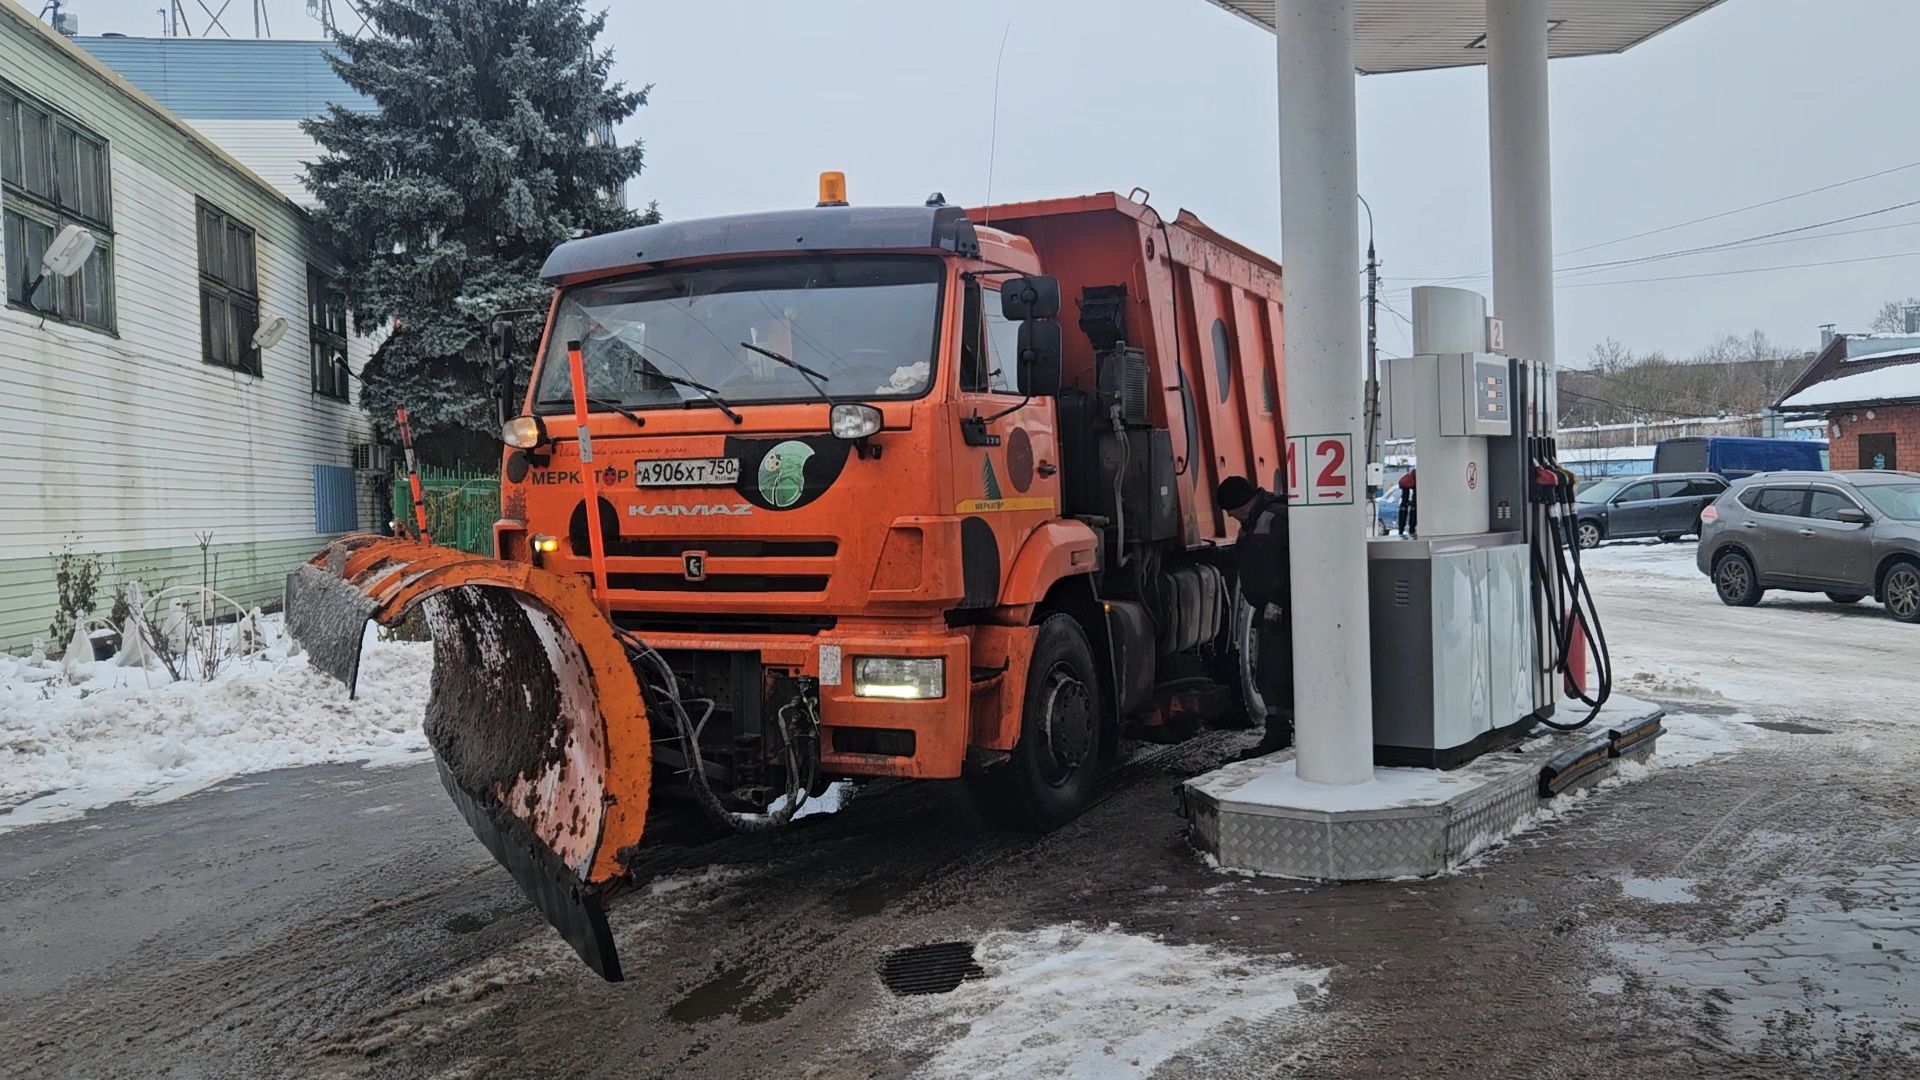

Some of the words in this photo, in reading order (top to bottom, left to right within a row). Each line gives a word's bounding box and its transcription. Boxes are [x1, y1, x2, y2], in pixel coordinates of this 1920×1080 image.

[1494, 322, 1500, 346] 2
[709, 460, 734, 475] 750
[1287, 442, 1296, 488] 1
[1316, 440, 1346, 487] 2
[532, 467, 629, 486] МЕРКТОР
[628, 503, 753, 517] KAMAZ
